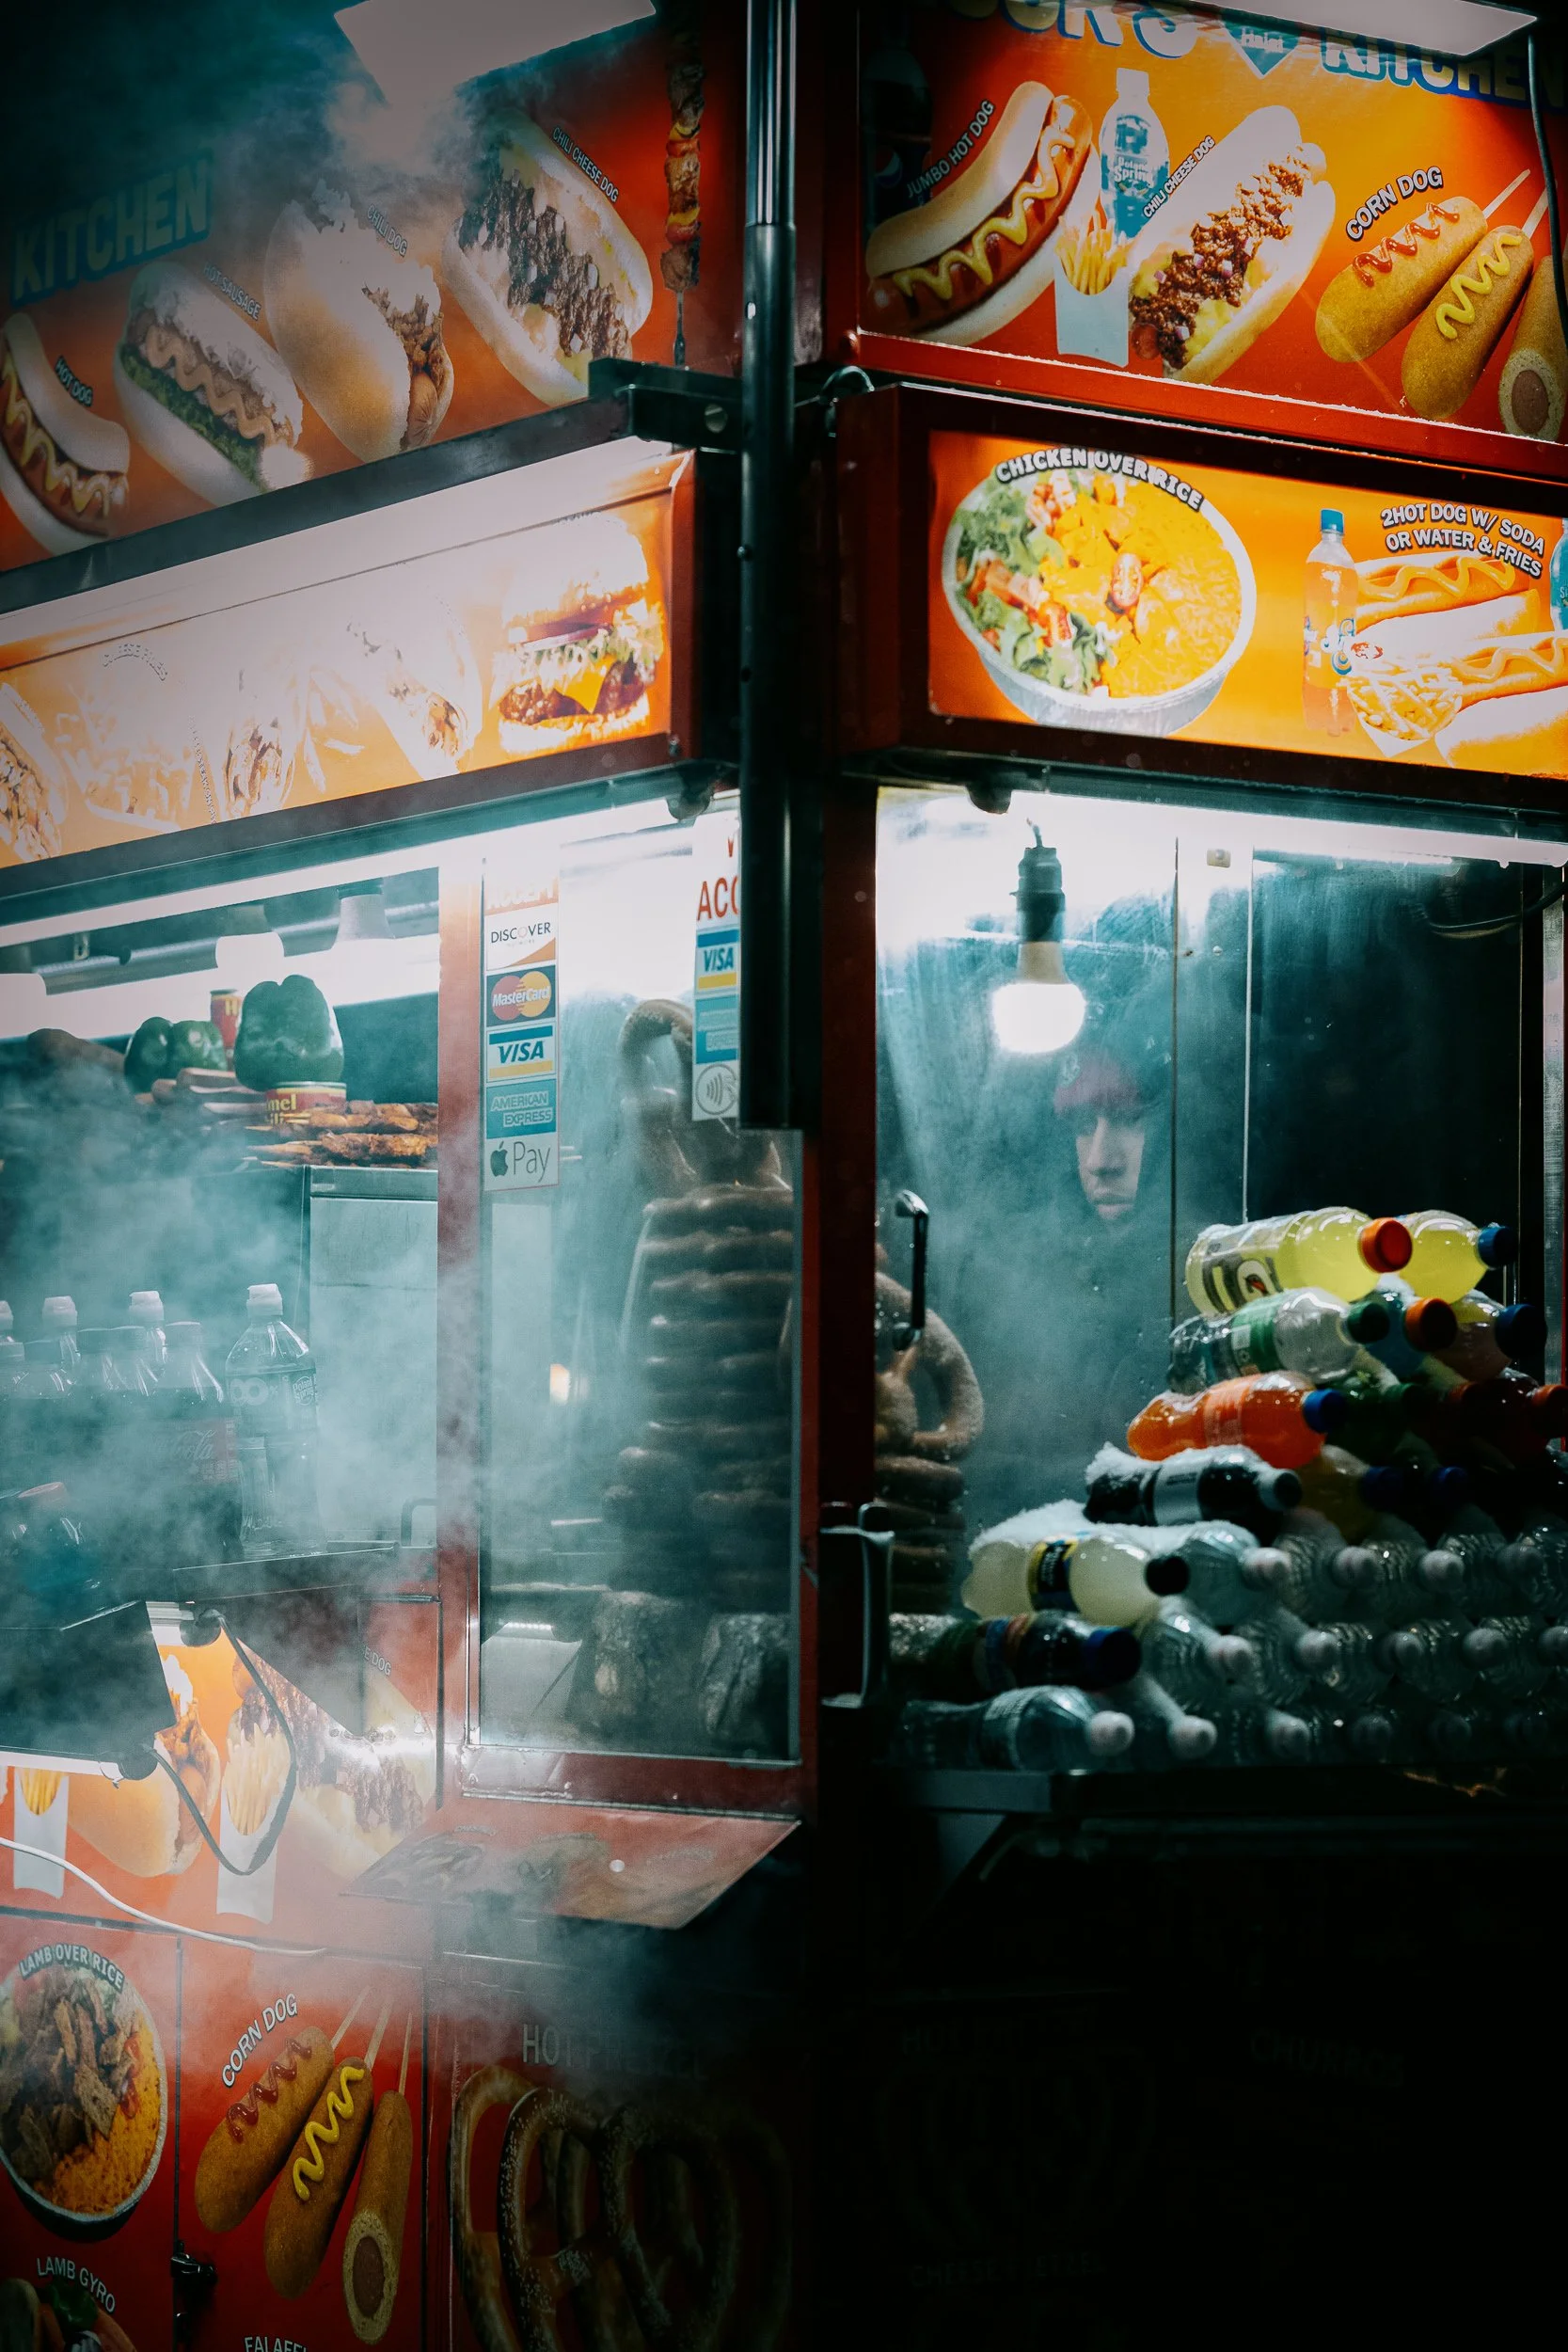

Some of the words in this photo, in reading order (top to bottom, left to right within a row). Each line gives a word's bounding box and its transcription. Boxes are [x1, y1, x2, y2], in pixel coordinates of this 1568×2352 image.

[551, 126, 575, 155] CHILI
[572, 147, 603, 184] CHEESE
[599, 176, 620, 203] DOG
[906, 159, 951, 199] JUMBO
[948, 132, 974, 166] HOT
[970, 100, 995, 138] DOG
[1143, 188, 1167, 218] CHILI
[1164, 153, 1198, 194] CHEESE
[1192, 135, 1216, 163] DOG
[12, 154, 211, 303] KITCHEN
[367, 202, 389, 238] CHILI
[387, 227, 407, 257] DOG
[1346, 183, 1398, 242] CORN
[1396, 166, 1444, 200] DOG
[220, 277, 261, 321] SAUSAGE
[995, 447, 1087, 484] CHICKEN
[1094, 450, 1149, 481] OVER
[1152, 466, 1204, 511] RICE
[1380, 503, 1426, 529] 2HOT
[1429, 502, 1466, 524] DOG
[1469, 507, 1498, 532] W/
[1500, 518, 1544, 555] SODA
[1386, 531, 1413, 552] OR
[1412, 528, 1475, 550] WATER
[1477, 535, 1493, 555] &
[1495, 541, 1543, 579] FRIES
[490, 922, 551, 944] DISCOVER
[703, 947, 735, 972] VISA
[492, 986, 550, 1008] MasterCard
[497, 1040, 545, 1064] VISA
[490, 1091, 548, 1111] AMERICAN
[503, 1107, 553, 1127] EXPRESS
[513, 1140, 551, 1183] Pay
[372, 1651, 392, 1677] DOG
[19, 1946, 52, 1978] LAMB
[55, 1943, 88, 1967] OVER
[92, 1951, 124, 1992] RICE
[221, 2019, 263, 2088] CORN
[261, 1993, 298, 2033] DOG
[37, 2256, 76, 2280] LAMB
[79, 2266, 116, 2313] GYRO
